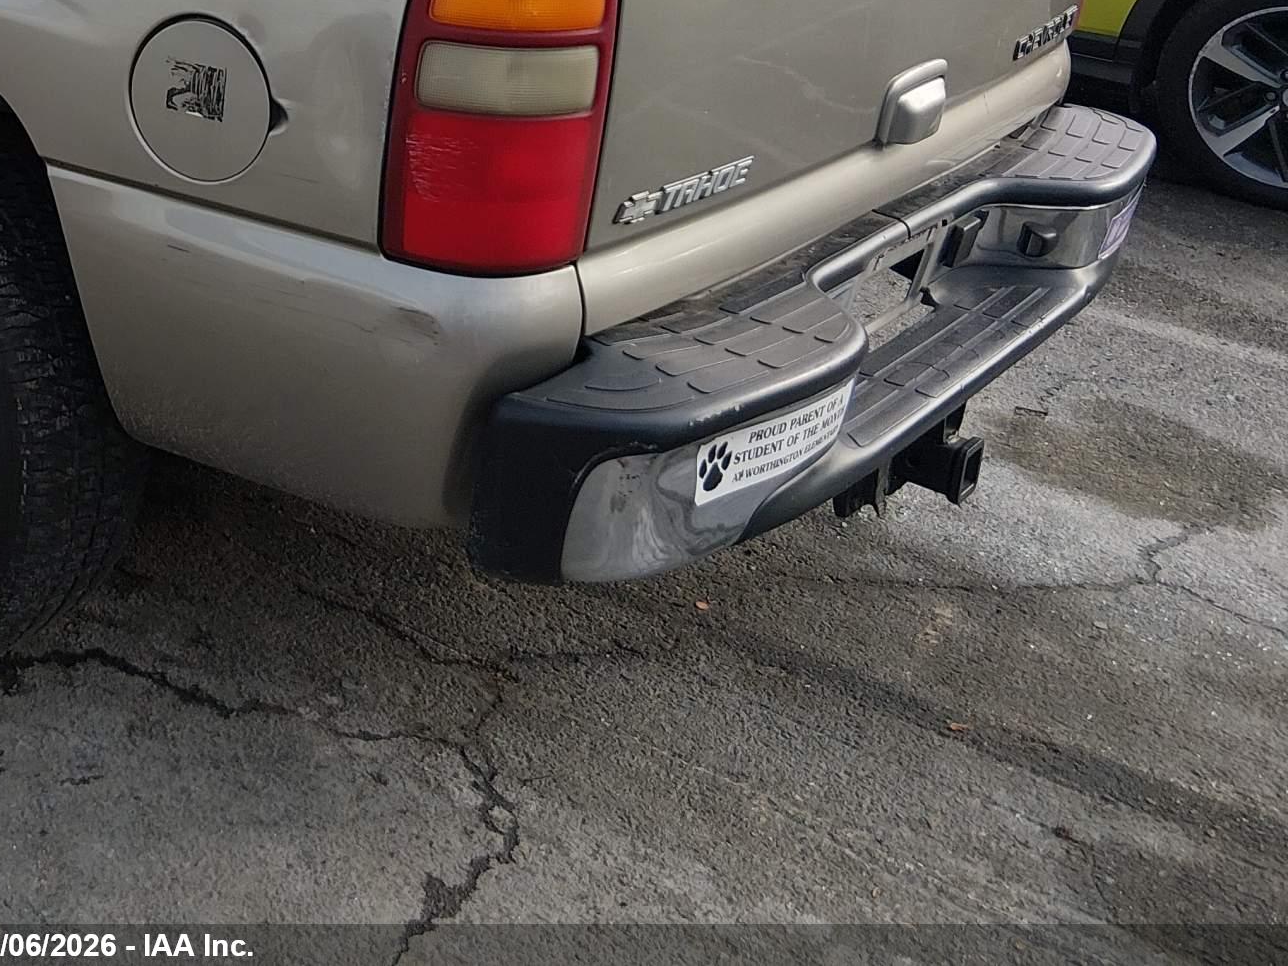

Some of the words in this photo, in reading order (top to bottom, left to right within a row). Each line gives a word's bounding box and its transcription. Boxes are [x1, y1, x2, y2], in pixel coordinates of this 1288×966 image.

[661, 155, 755, 212] TAHOE
[733, 438, 786, 465] STUDENT
[786, 431, 801, 448] OF
[802, 421, 822, 441] THE
[748, 421, 788, 444] PROUD
[789, 404, 826, 431] PARENT
[826, 397, 839, 413] OF
[745, 447, 804, 479] WORTHINGTON
